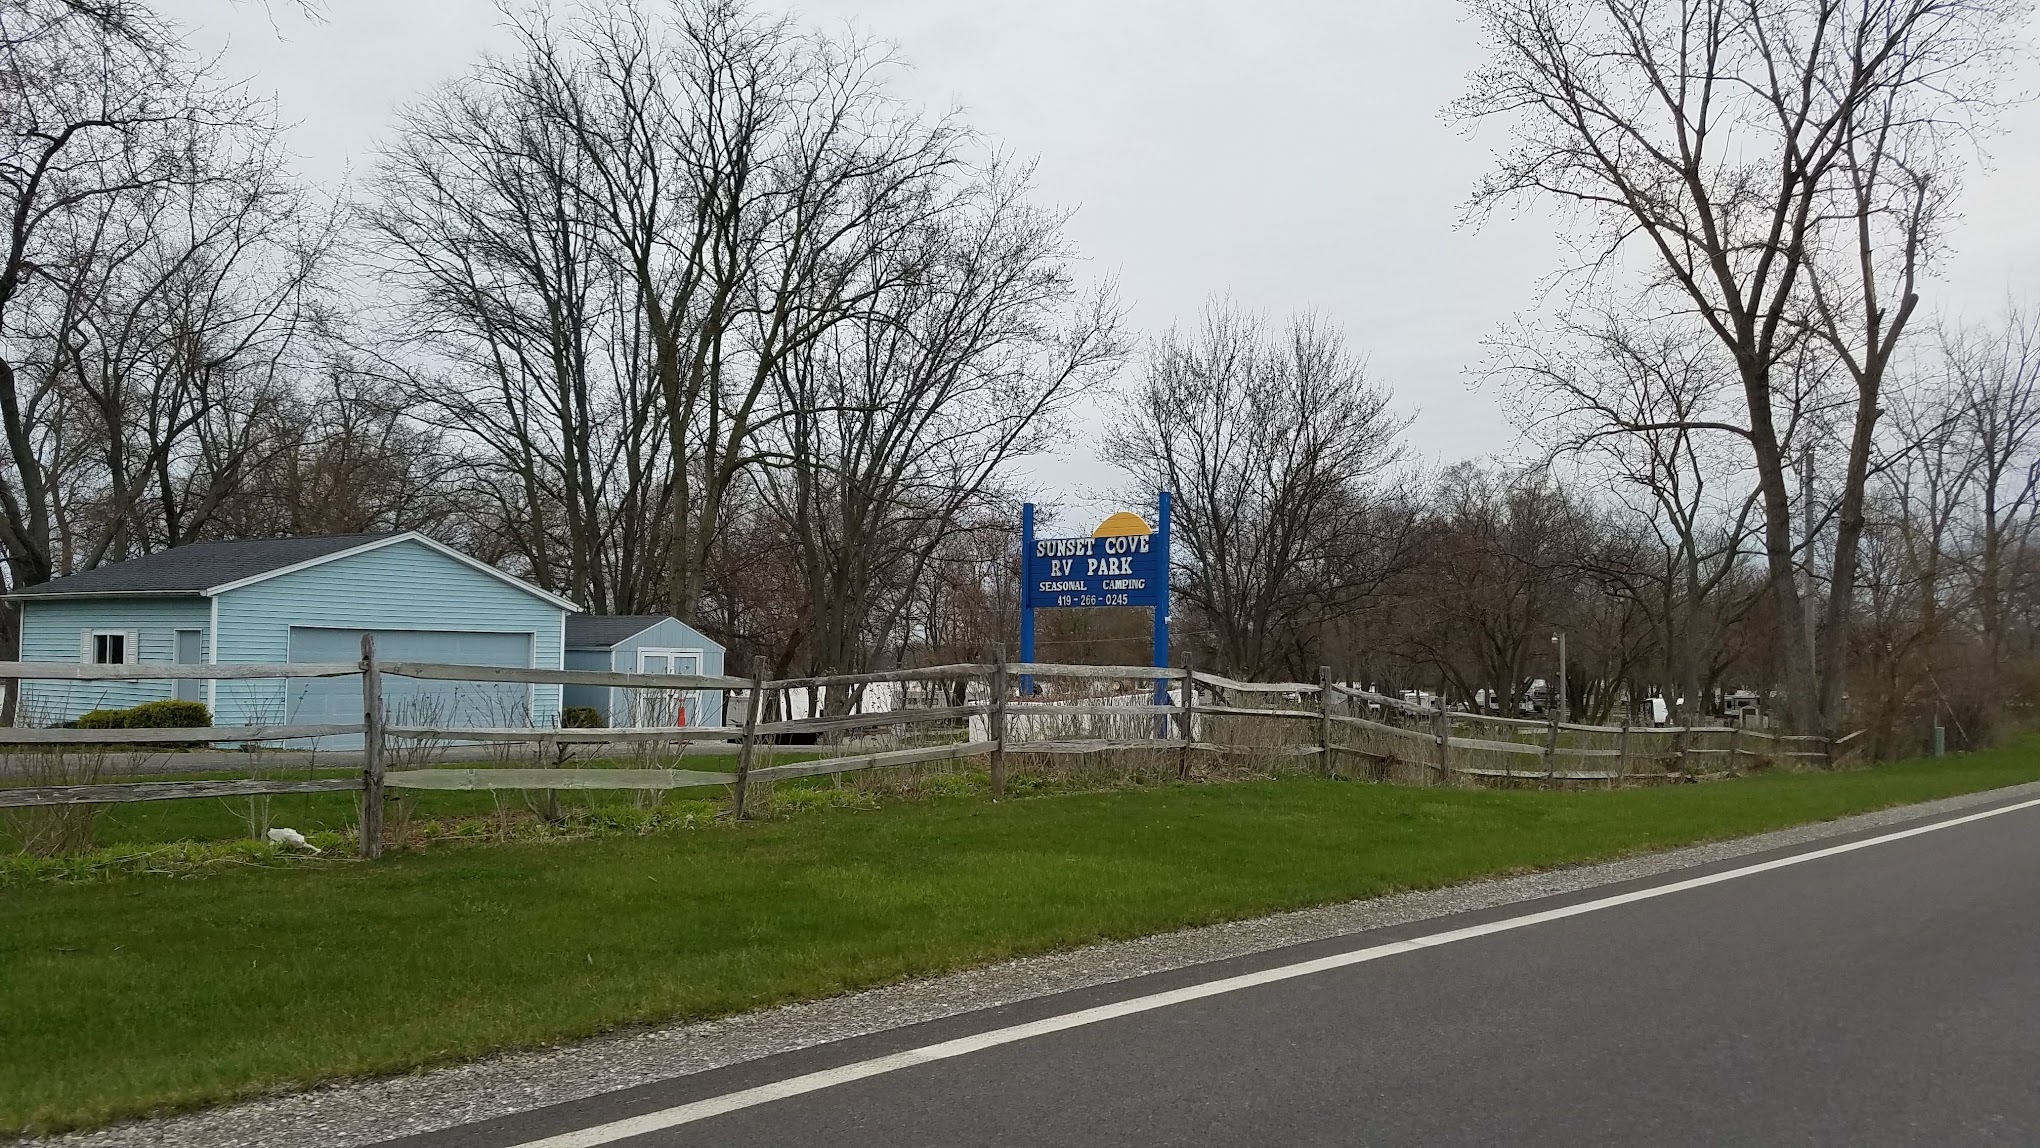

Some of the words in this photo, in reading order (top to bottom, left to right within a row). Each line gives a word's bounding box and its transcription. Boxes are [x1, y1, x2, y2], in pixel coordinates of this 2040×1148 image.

[1036, 539, 1095, 557] SUNSET
[1105, 535, 1150, 555] COVE
[1050, 559, 1073, 577] RV
[1087, 557, 1133, 576] PARK
[1039, 581, 1088, 592] SEASONAL
[1102, 579, 1146, 591] CAMPING
